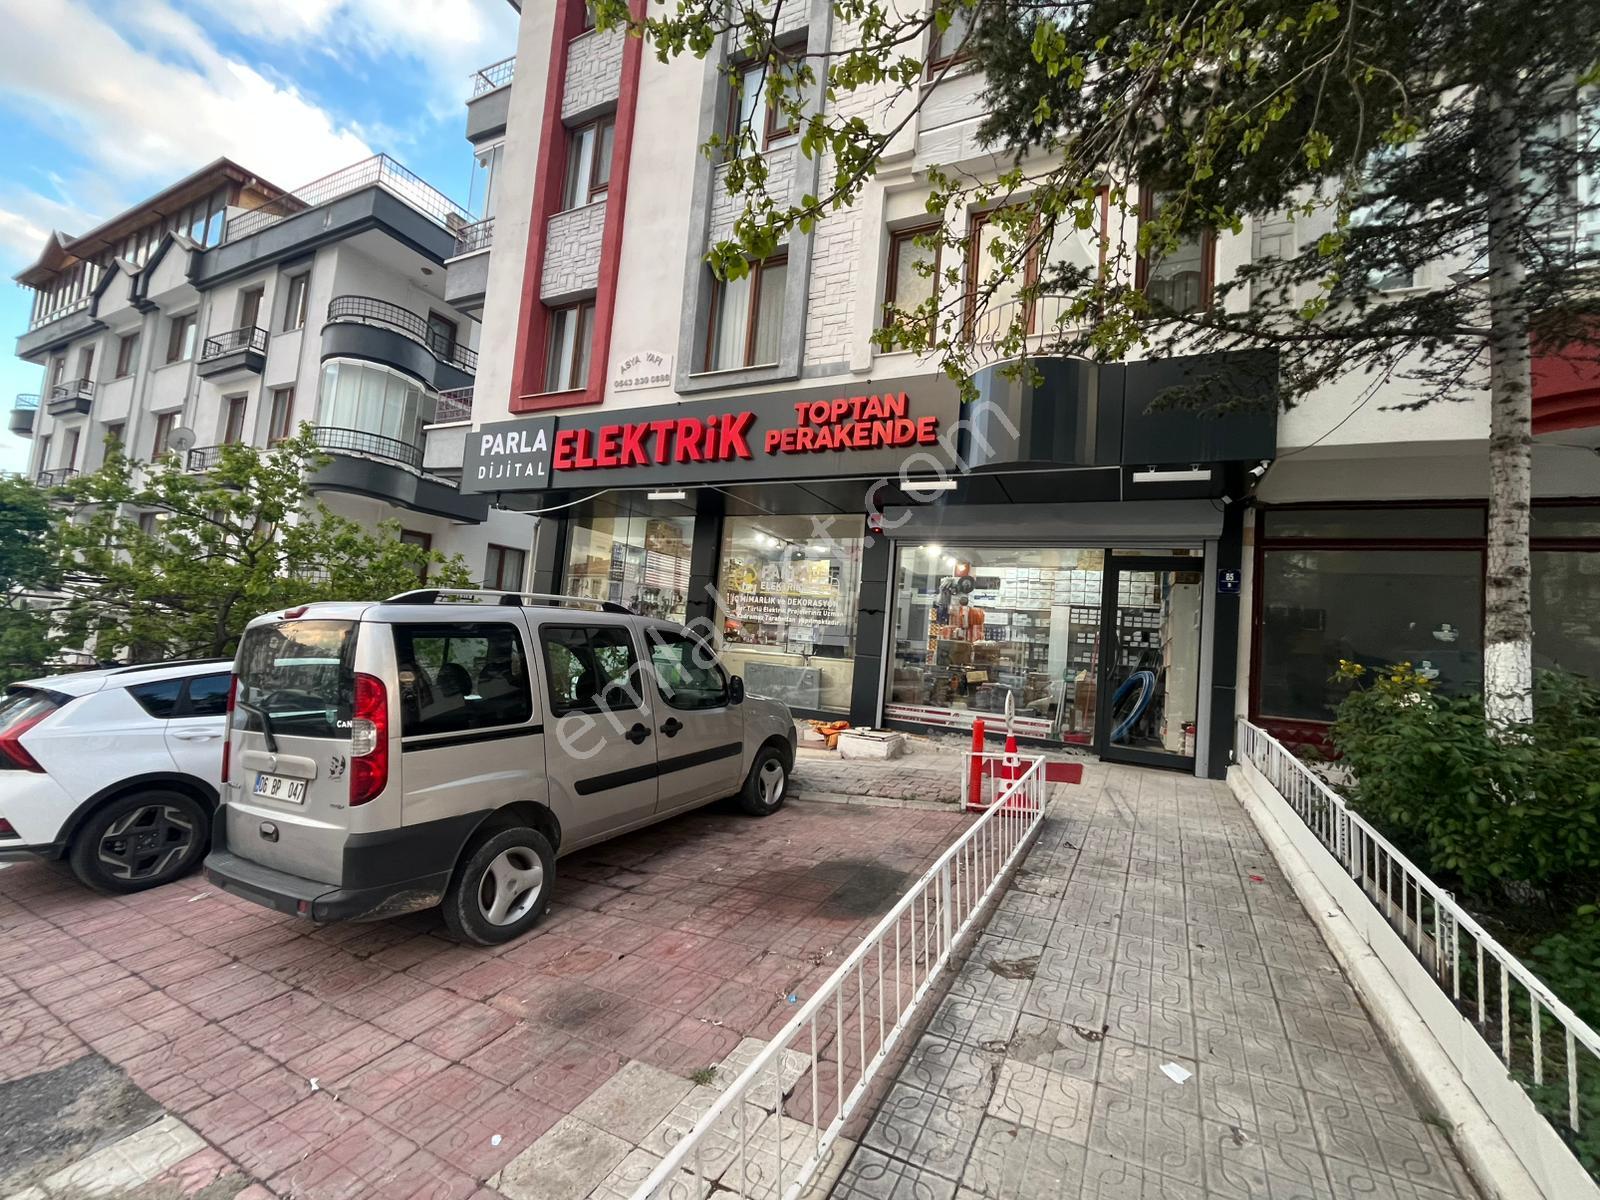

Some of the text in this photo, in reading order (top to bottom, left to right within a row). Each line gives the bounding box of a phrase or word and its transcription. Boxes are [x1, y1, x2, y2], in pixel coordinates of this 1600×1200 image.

[621, 353, 663, 374] ASYA YAPI
[794, 391, 908, 426] TOPTAN
[480, 428, 548, 457] PARLA
[763, 415, 938, 455] PERAKENDE
[478, 460, 546, 480] DİJİTAL
[336, 719, 353, 728] CAN
[258, 776, 305, 801] 06 BP 047
